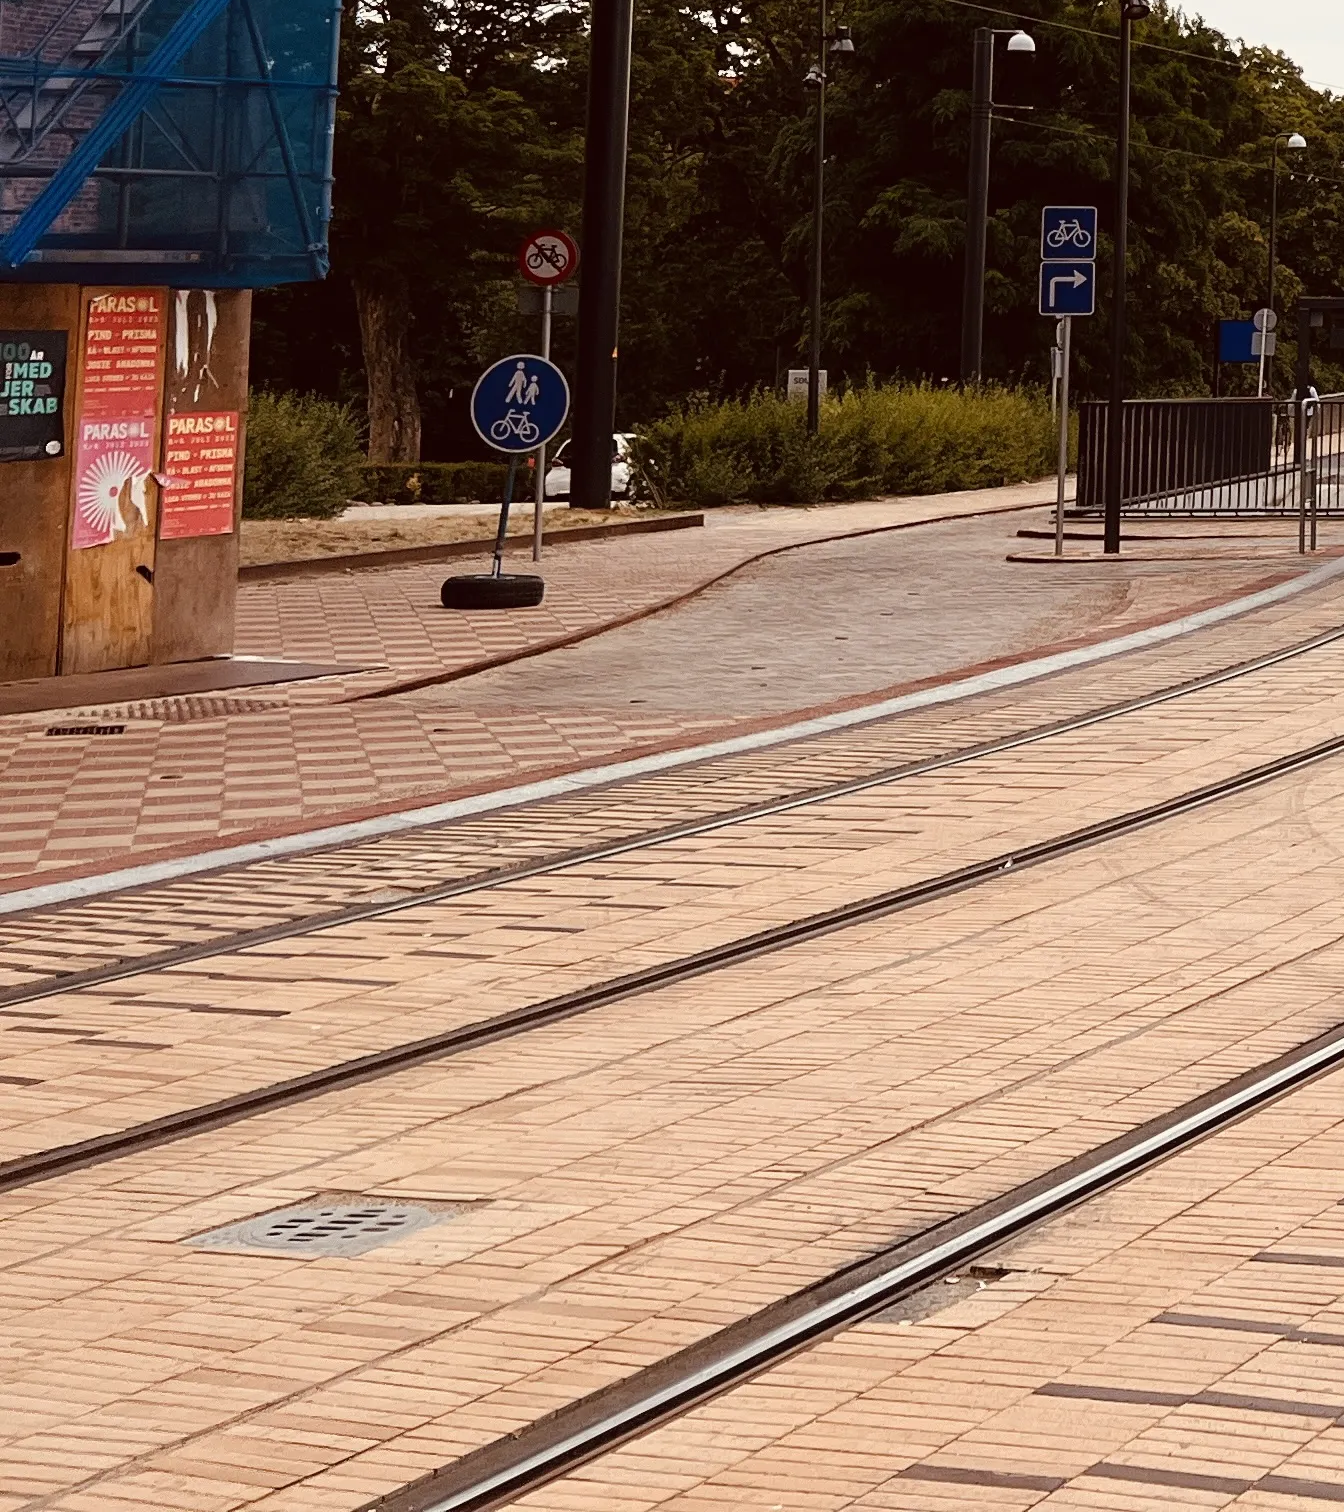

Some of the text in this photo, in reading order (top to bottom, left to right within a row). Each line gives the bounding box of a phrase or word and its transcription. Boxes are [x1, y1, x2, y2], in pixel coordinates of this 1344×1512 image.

[90, 296, 159, 314] PARASOL
[13, 361, 52, 379] MED
[8, 396, 58, 415] SKAB
[83, 421, 149, 441] PARASOL
[169, 415, 235, 435] PARASOL
